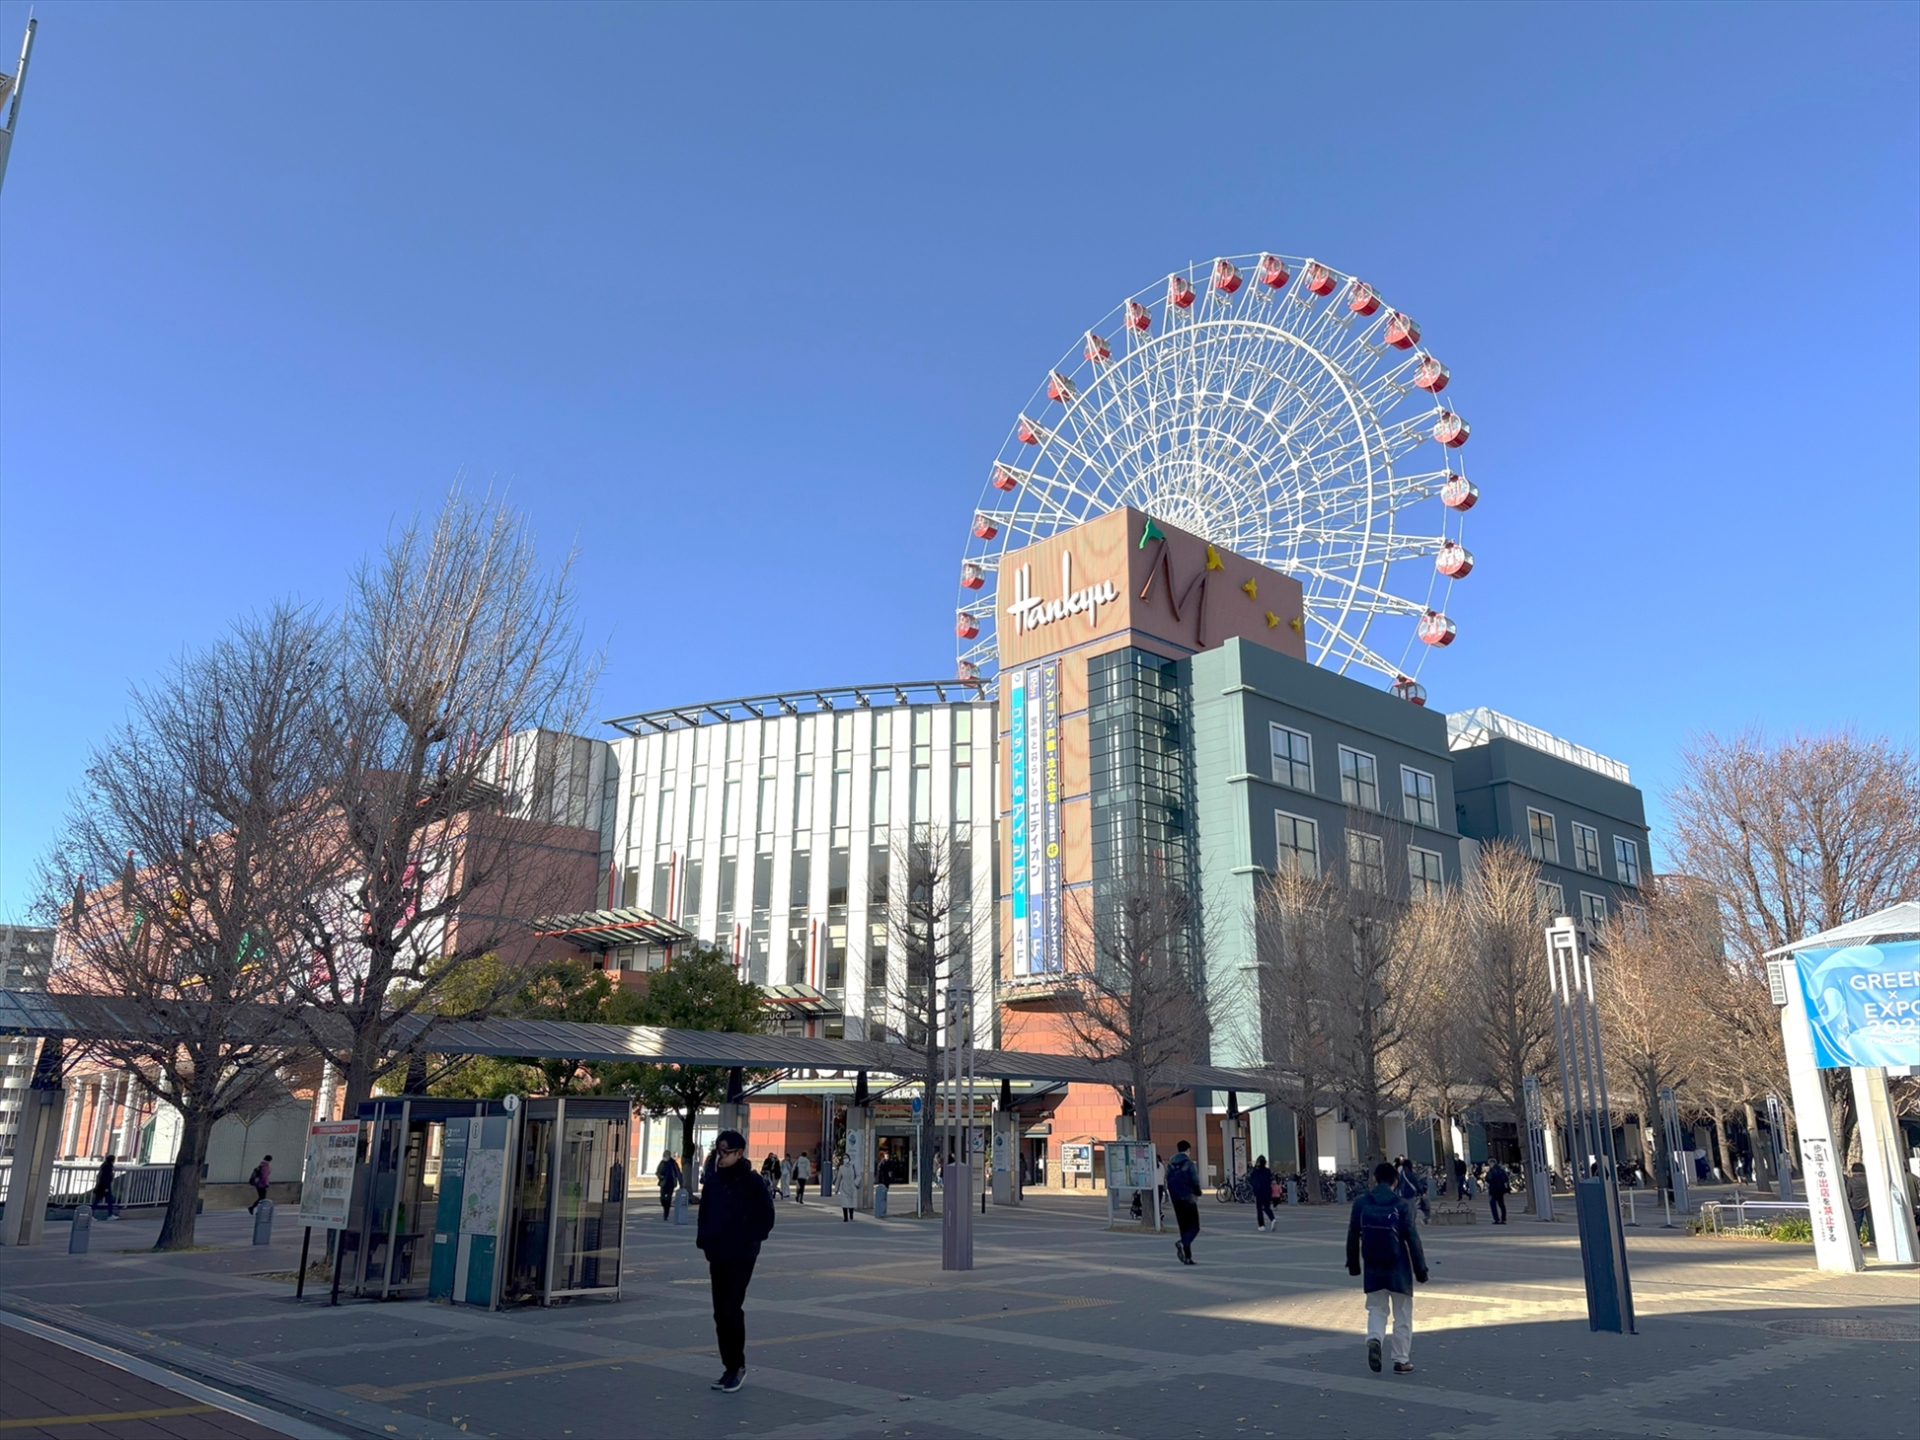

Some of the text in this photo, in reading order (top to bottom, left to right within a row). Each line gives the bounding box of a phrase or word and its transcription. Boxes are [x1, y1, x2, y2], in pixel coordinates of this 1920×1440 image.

[1006, 550, 1119, 635] Hankyu
[1013, 707, 1025, 895] コンタクトのアイシティ
[1016, 928, 1025, 964] 4F
[1031, 910, 1041, 957] 3F
[1866, 1017, 1920, 1034] 202
[1813, 1144, 1836, 1242] 歩道での出店を禁止する
